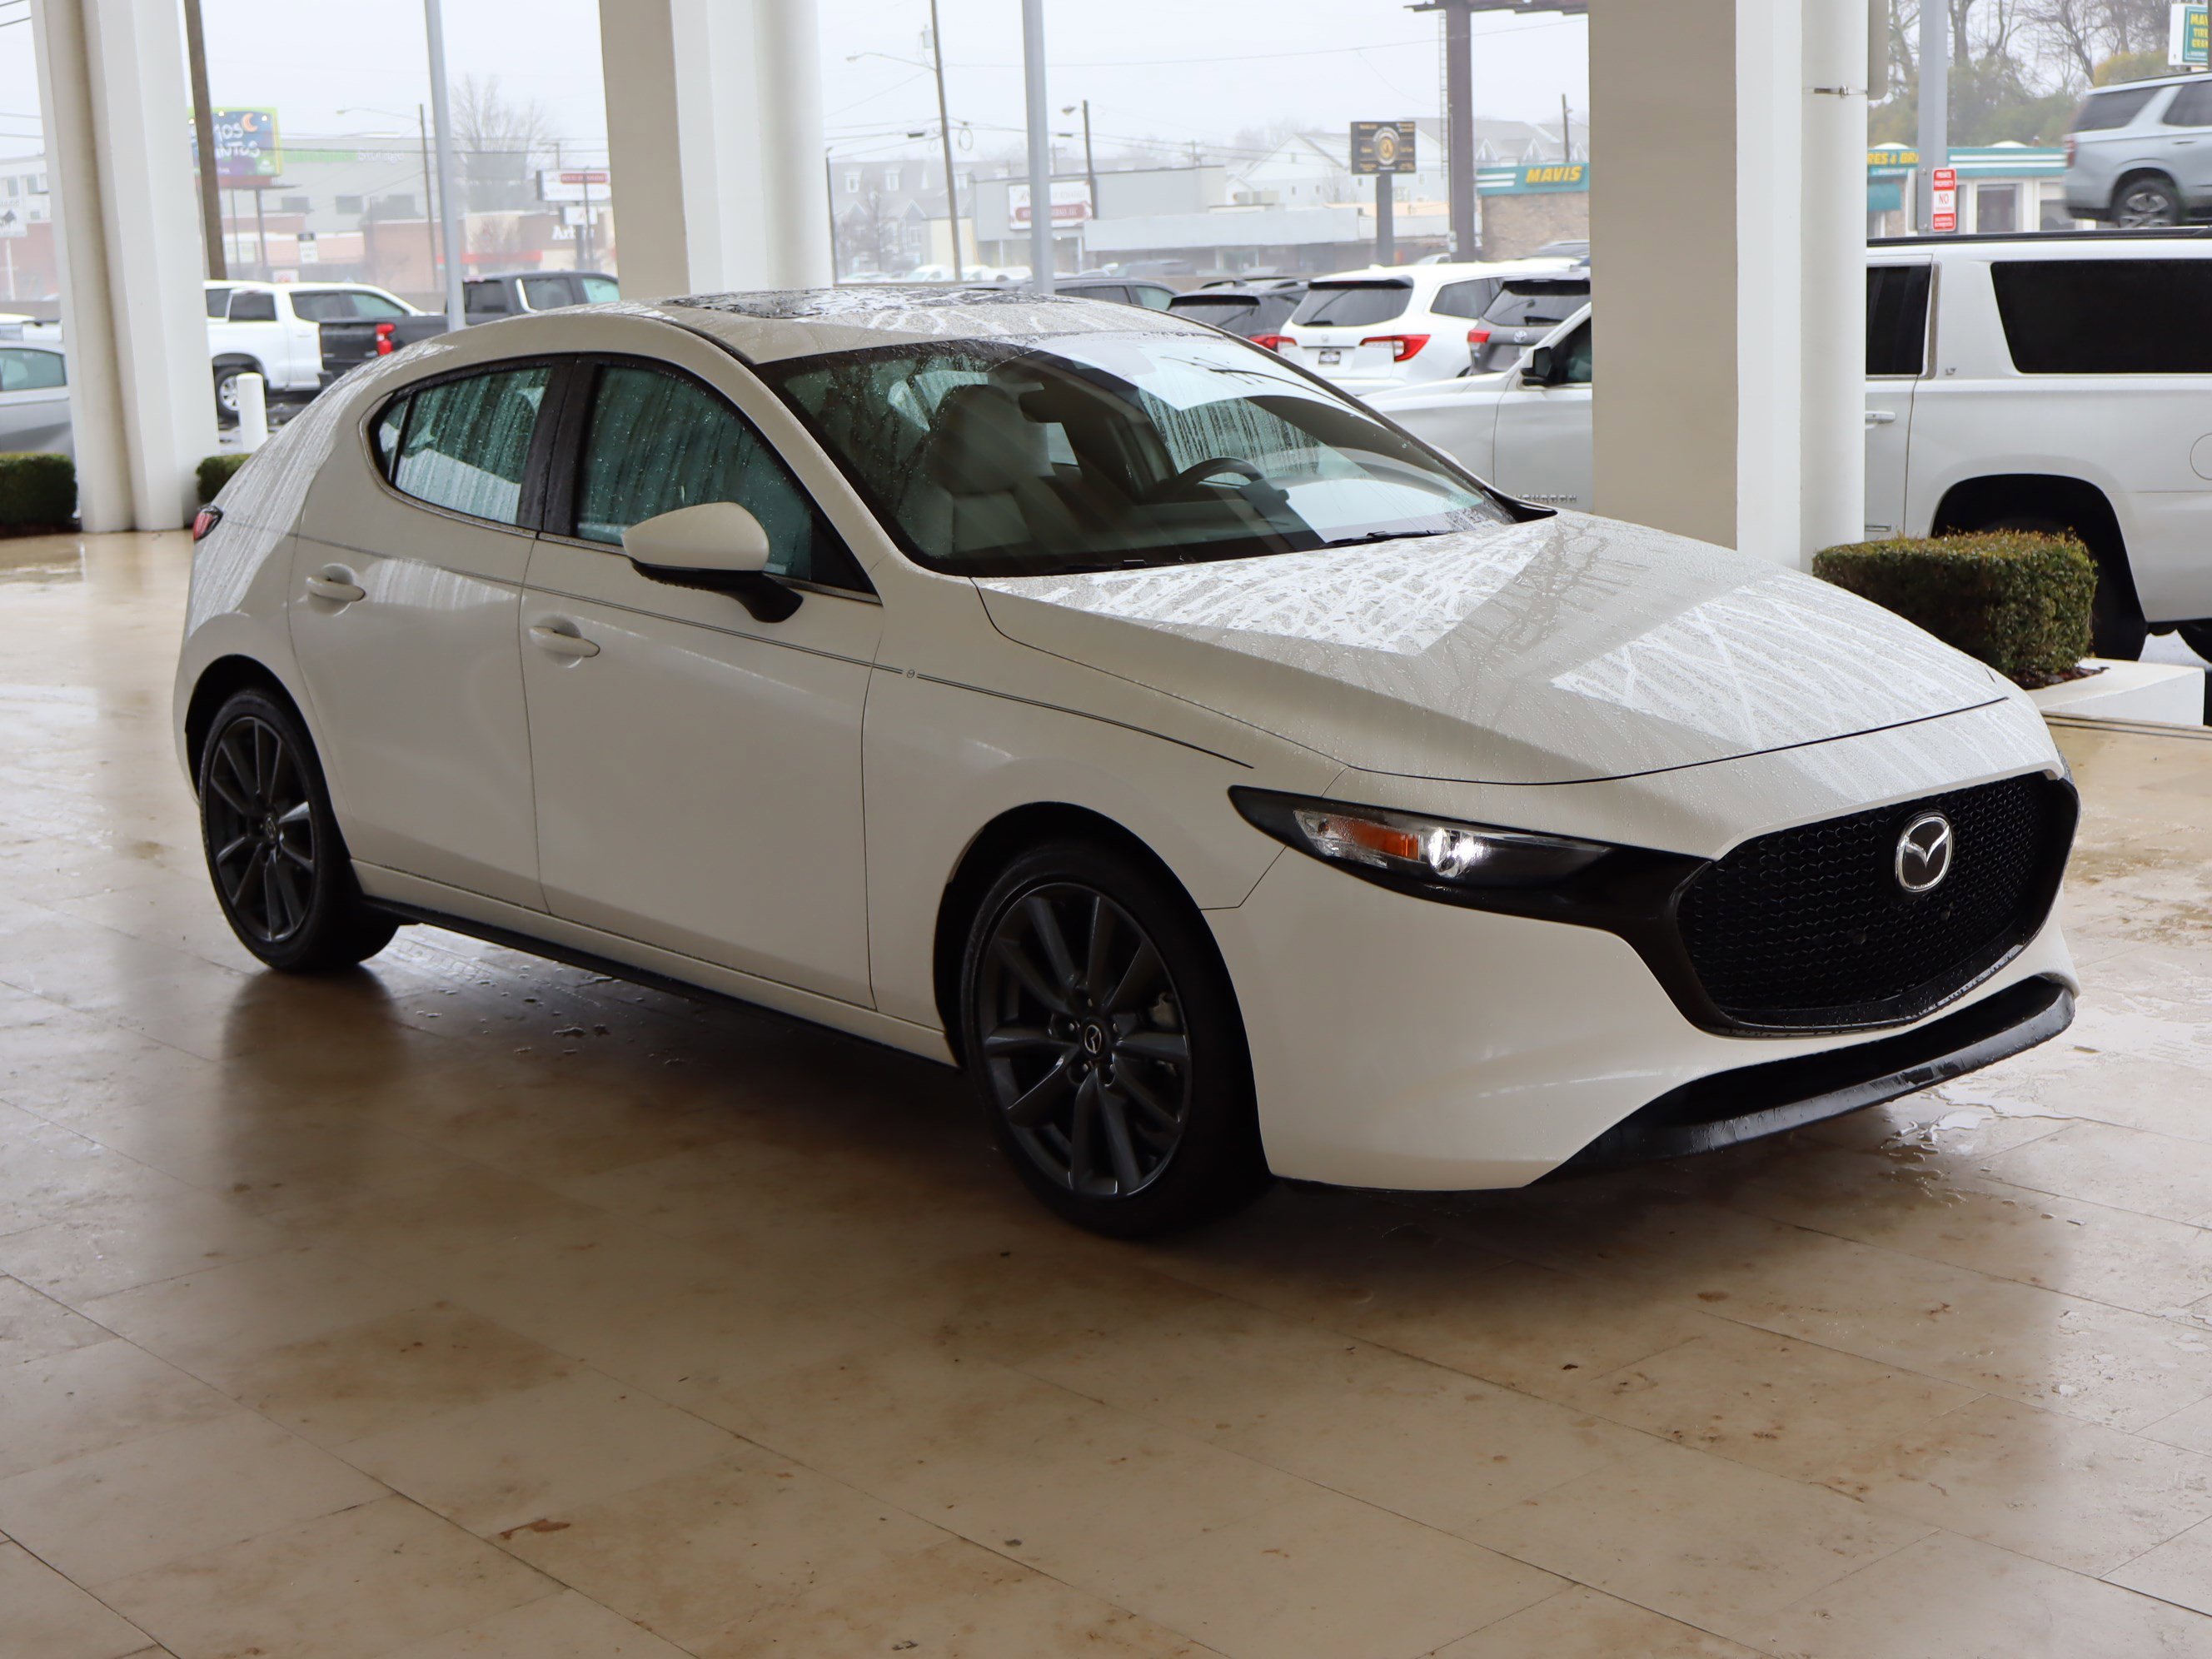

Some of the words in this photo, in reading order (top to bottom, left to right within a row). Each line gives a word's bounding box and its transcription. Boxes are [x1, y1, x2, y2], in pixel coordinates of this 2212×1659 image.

[1867, 152, 1888, 166] RES
[1526, 165, 1582, 183] MAVIS
[1939, 192, 1950, 206] NO
